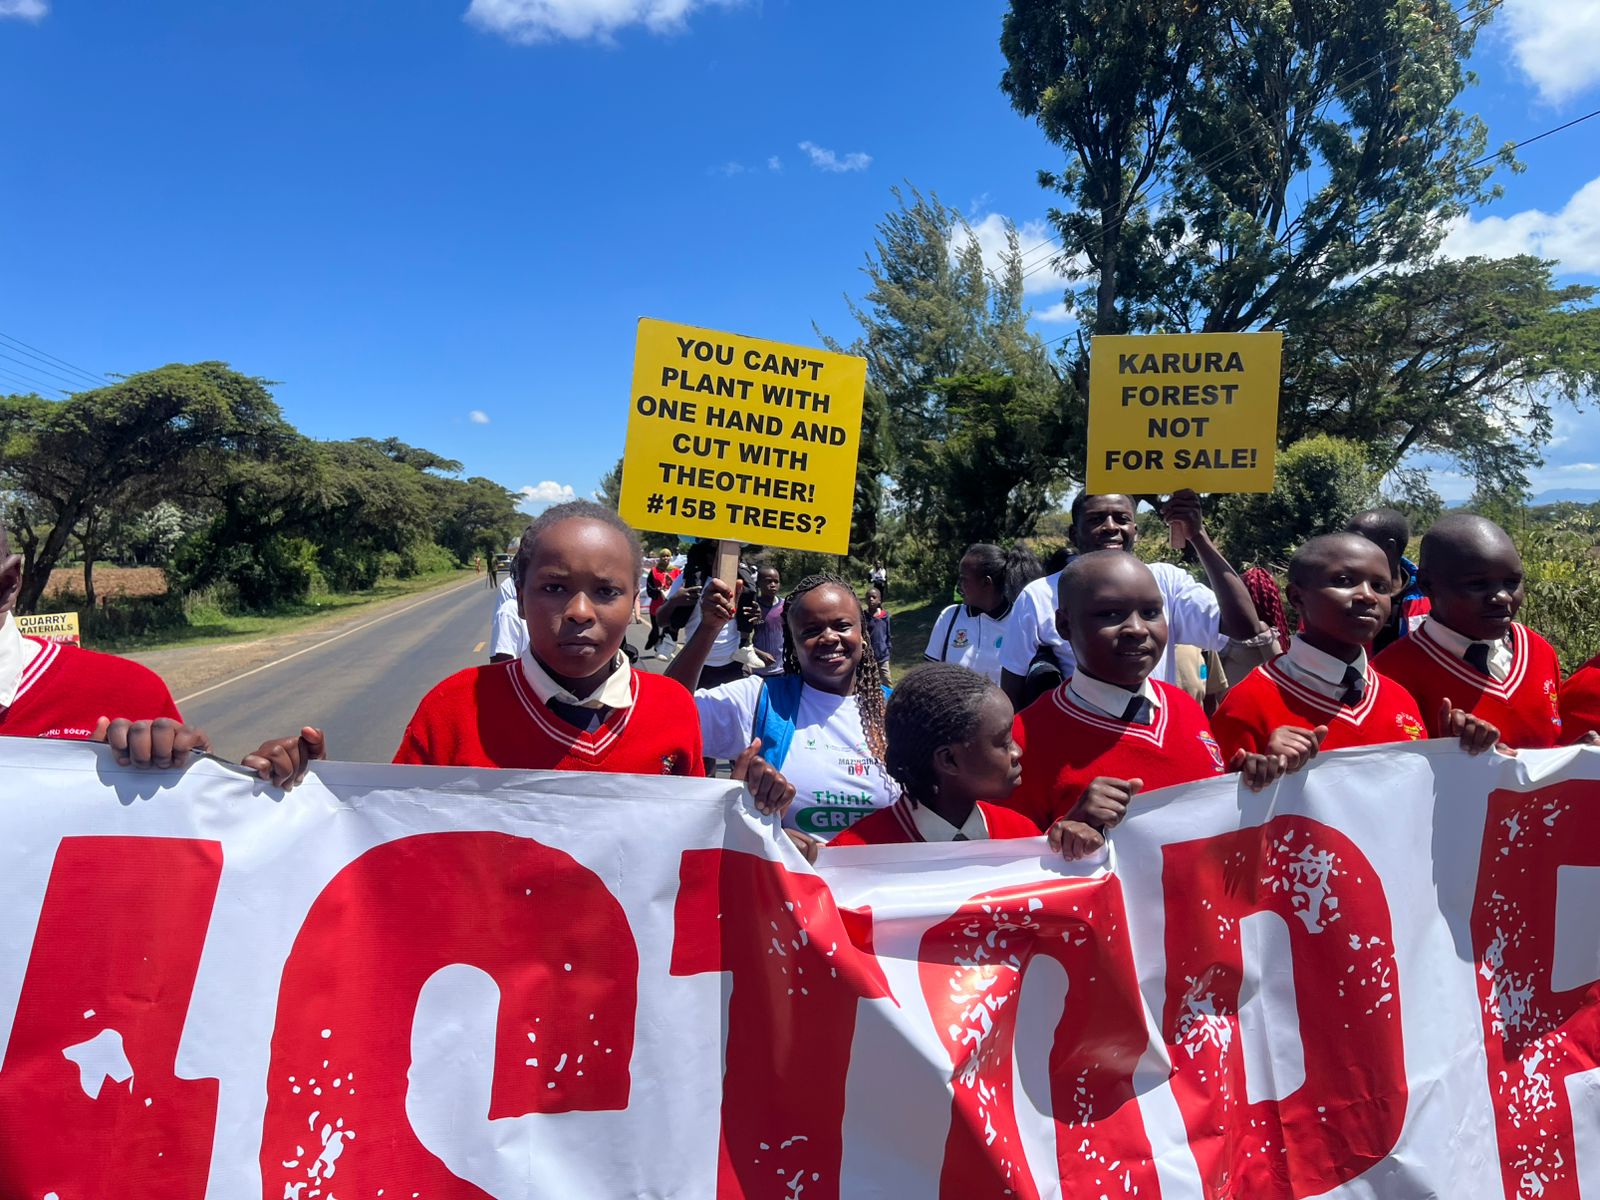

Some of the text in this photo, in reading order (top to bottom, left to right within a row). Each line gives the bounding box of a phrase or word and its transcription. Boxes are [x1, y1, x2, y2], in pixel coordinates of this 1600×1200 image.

[677, 336, 824, 381] YOU CAN'T
[1118, 352, 1244, 375] KARURA
[661, 366, 830, 413] PLANT WITH
[1121, 384, 1239, 407] FOREST
[636, 395, 846, 446] ONE HAND AND
[1147, 417, 1210, 438] NOT
[672, 433, 808, 471] CUT WITH
[1105, 448, 1257, 471] FOR SALE!
[658, 462, 815, 503] THEOTHER!
[647, 493, 827, 535] #15B TREES?
[18, 623, 73, 634] MATERIALS
[20, 614, 67, 627] QUARRY
[812, 790, 873, 806] Think
[811, 811, 872, 828] GRE
